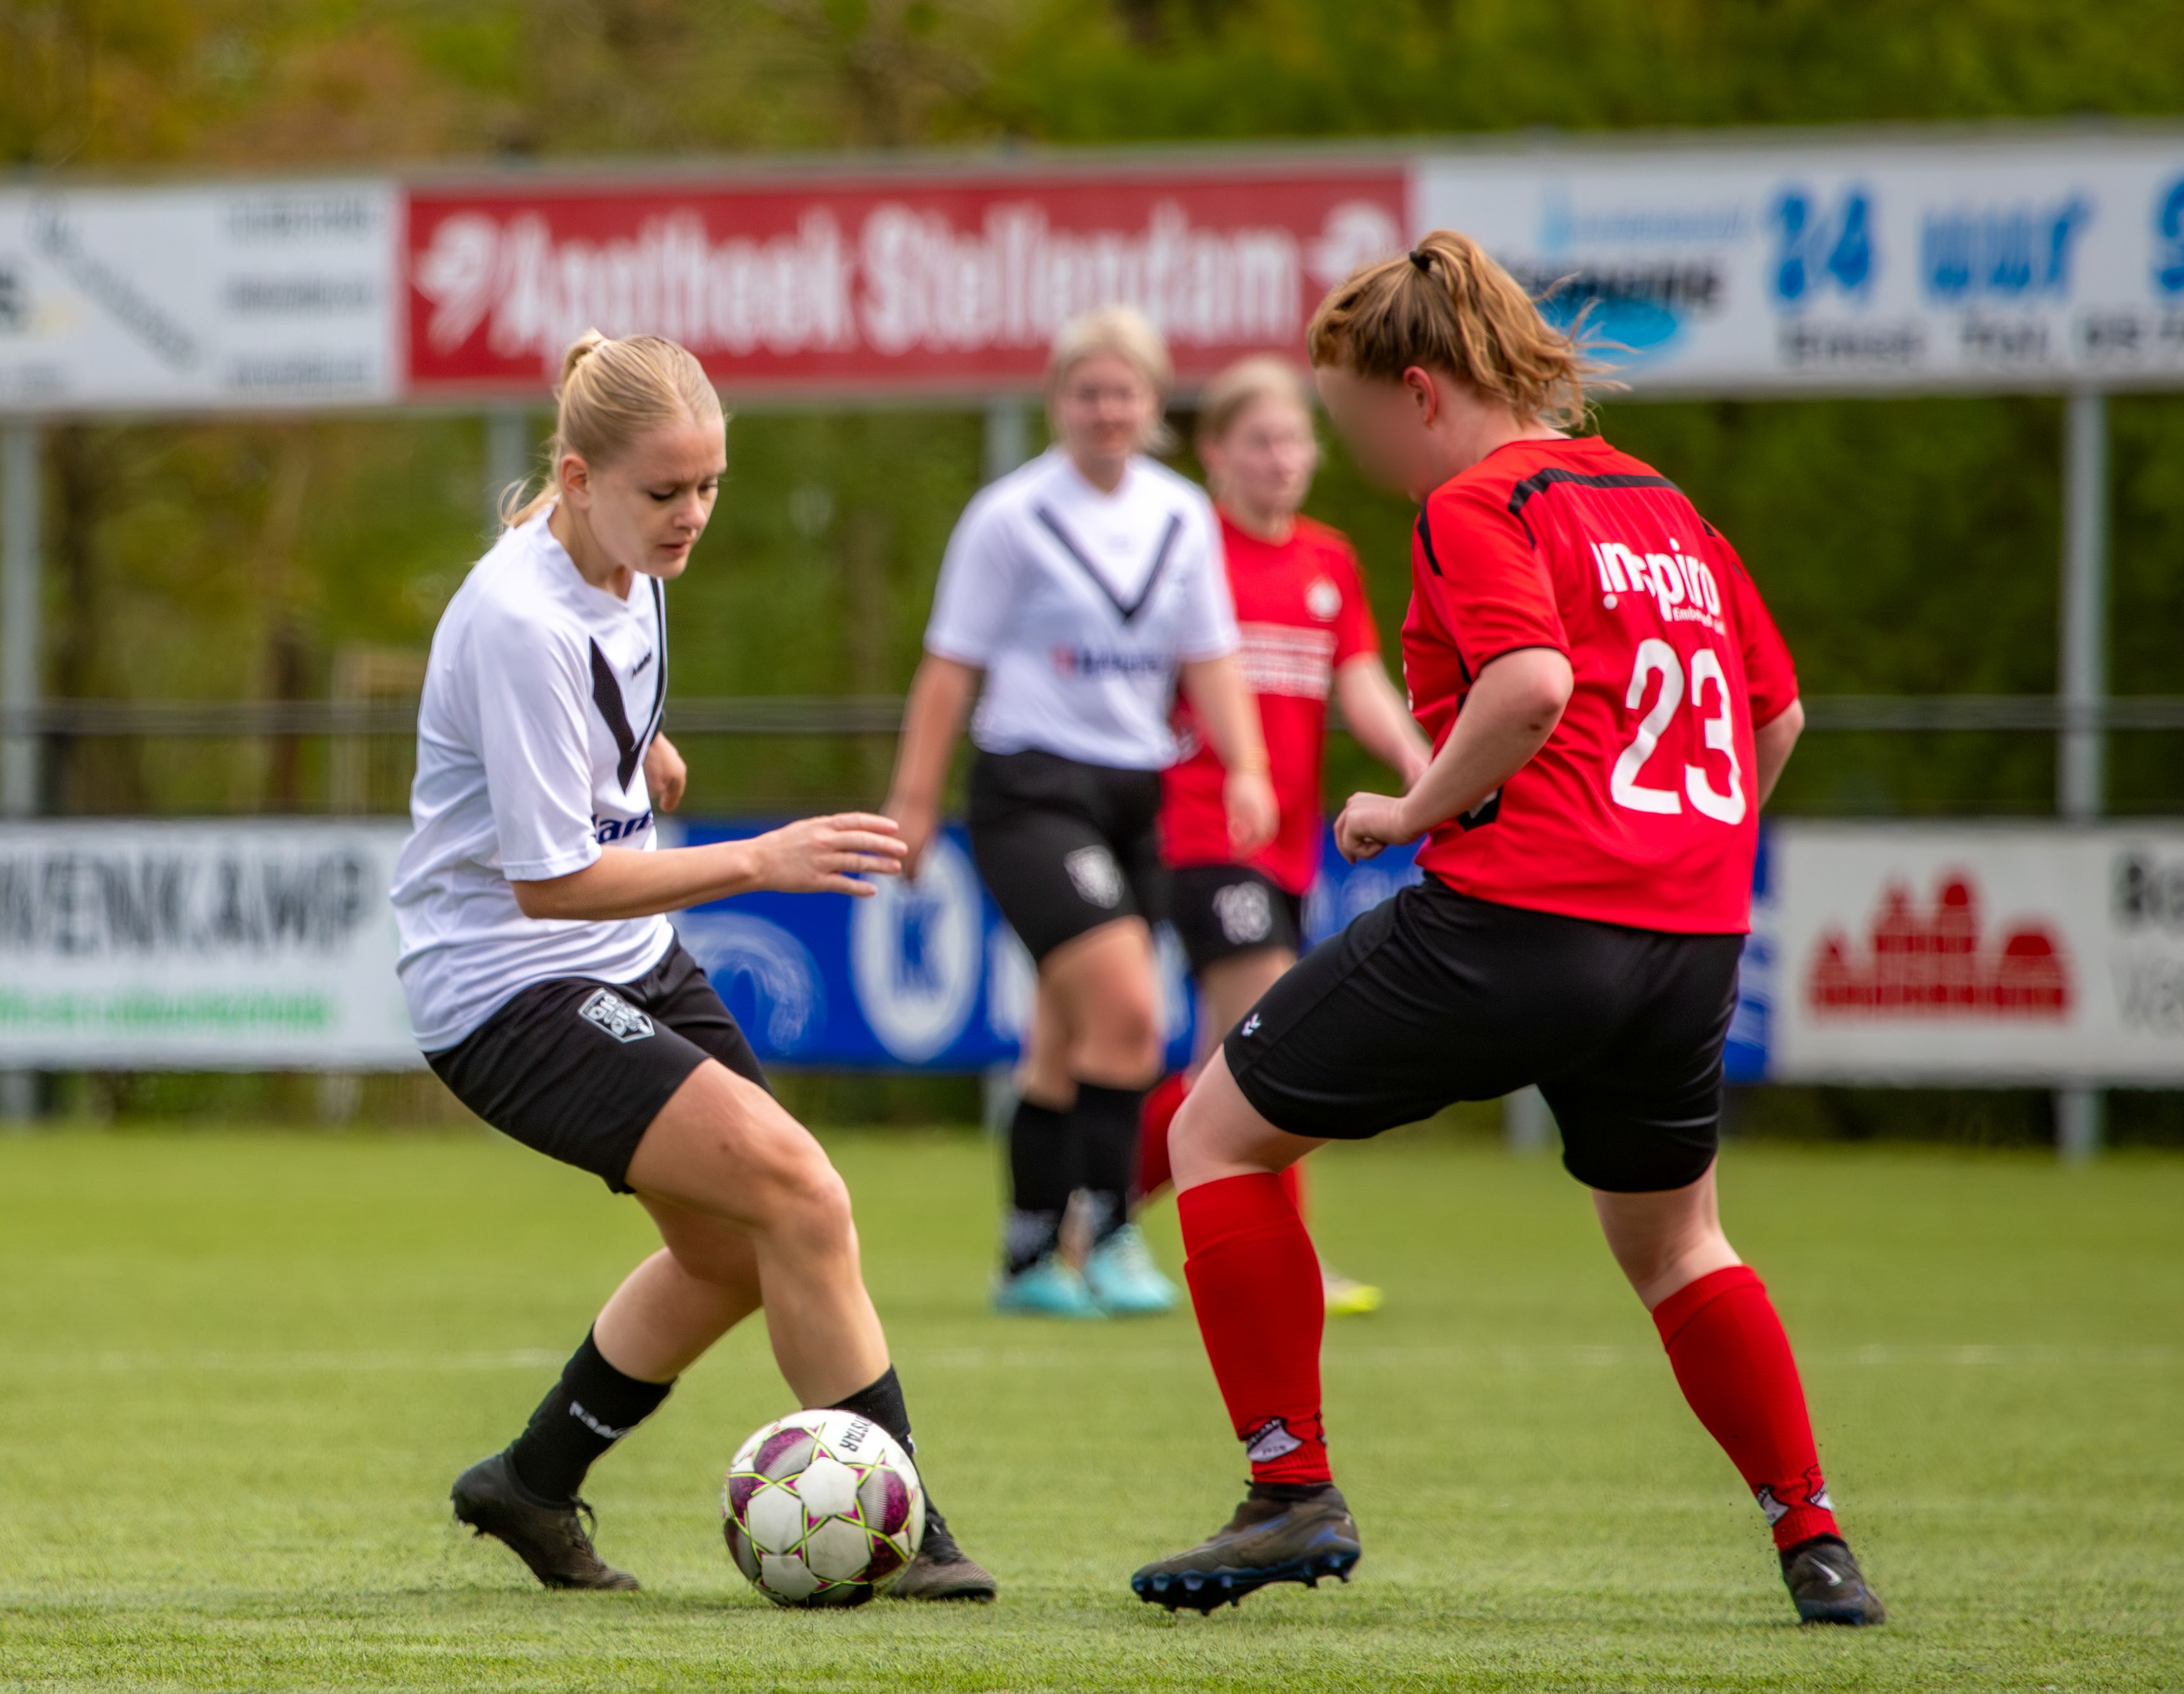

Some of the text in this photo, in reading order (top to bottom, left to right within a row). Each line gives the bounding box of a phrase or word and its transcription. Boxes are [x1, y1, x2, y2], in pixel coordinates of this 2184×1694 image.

[492, 201, 1301, 375] Apotheek Stellendam
[1769, 183, 1879, 307] 24
[1610, 638, 1746, 824] 23
[839, 1415, 872, 1453] YSTAR
